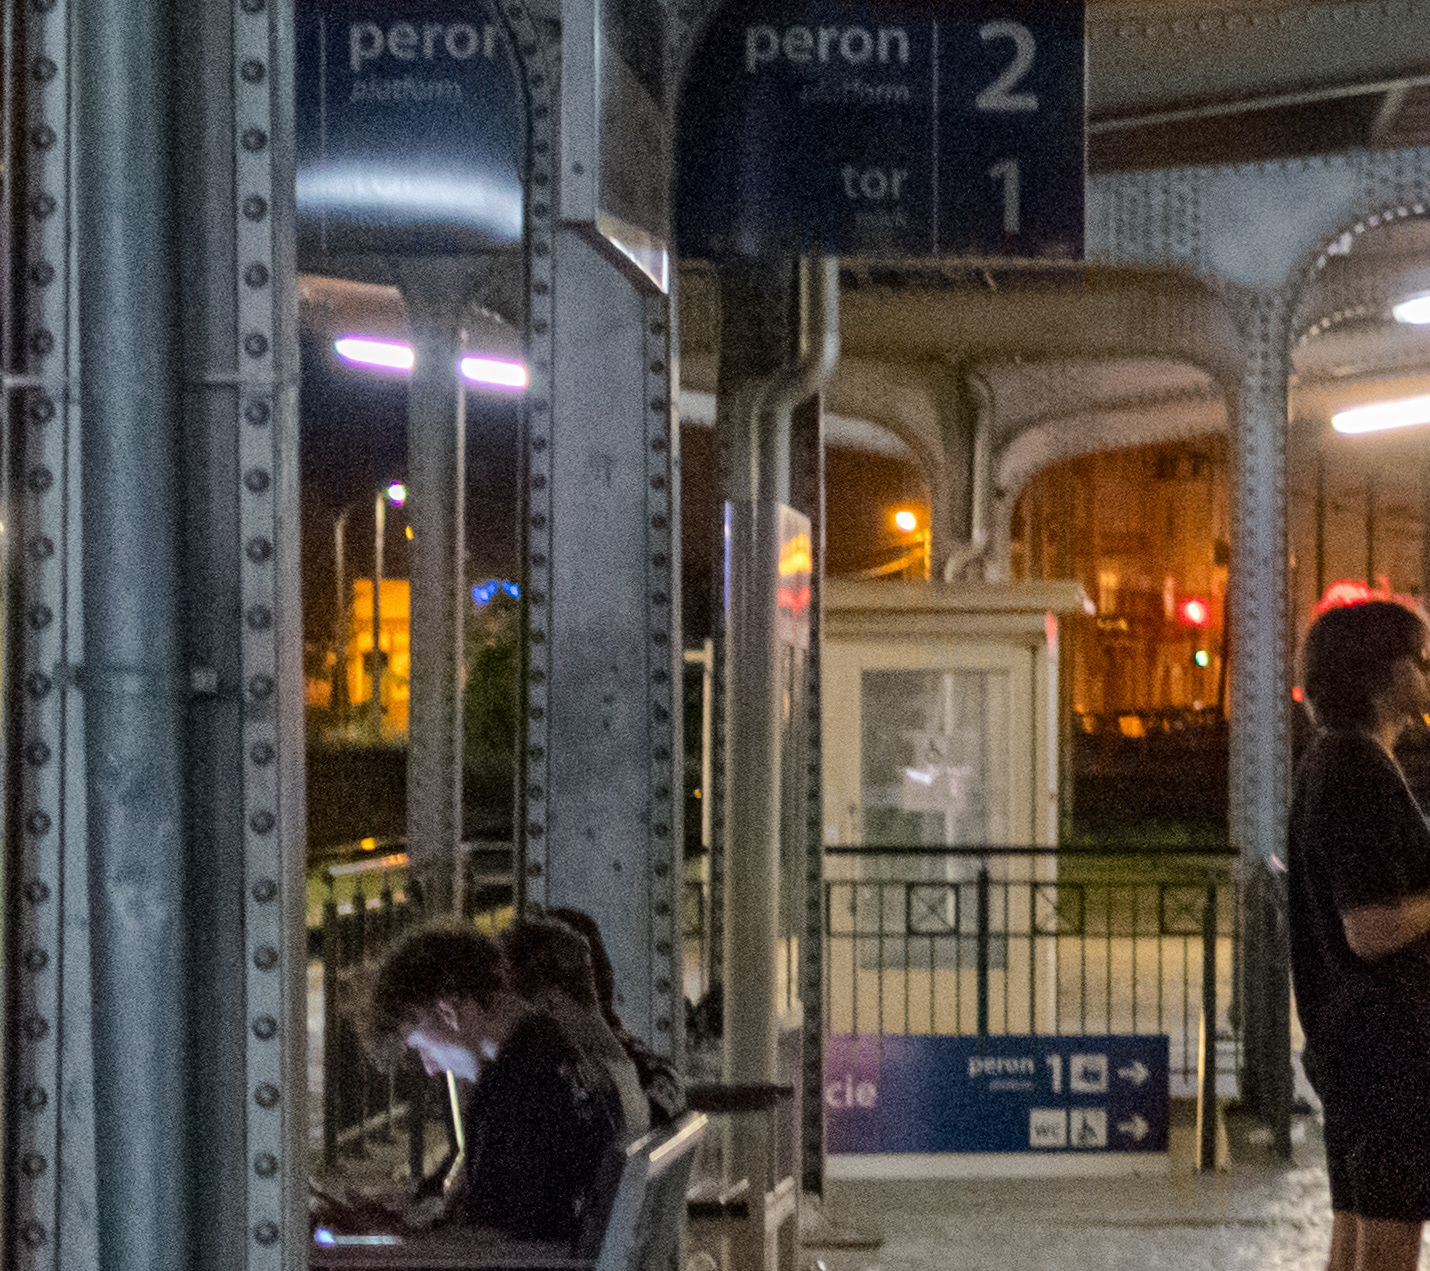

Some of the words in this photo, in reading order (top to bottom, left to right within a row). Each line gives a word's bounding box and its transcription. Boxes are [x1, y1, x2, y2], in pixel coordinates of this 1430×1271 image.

[743, 23, 911, 74] peron
[973, 17, 1040, 112] 2
[840, 163, 909, 200] tor
[986, 157, 1021, 233] 1
[967, 1056, 1036, 1080] peron
[1045, 1053, 1064, 1094] 1
